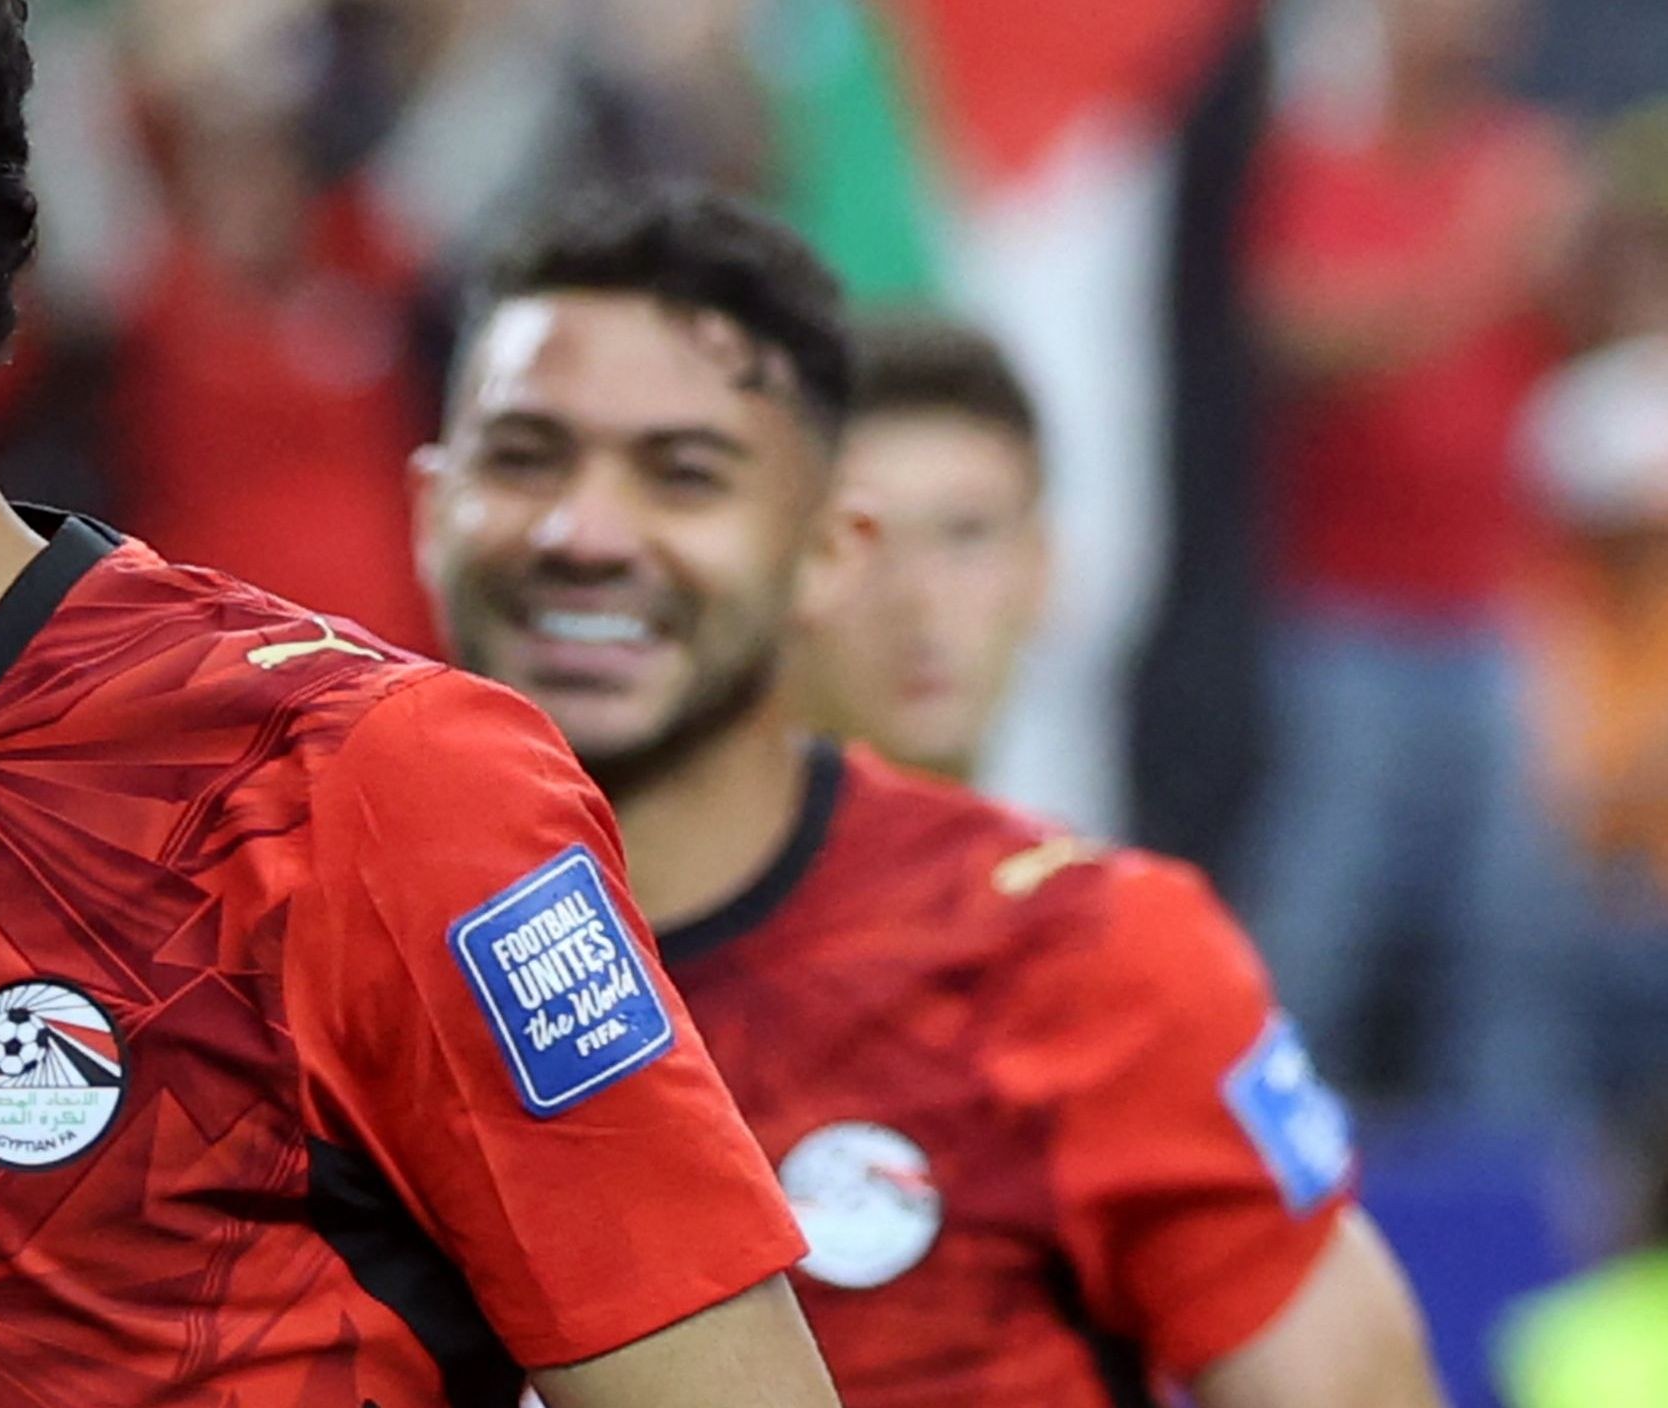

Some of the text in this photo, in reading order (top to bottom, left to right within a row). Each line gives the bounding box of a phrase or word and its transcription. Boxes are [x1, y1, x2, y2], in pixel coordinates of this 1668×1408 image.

[492, 890, 597, 971] FOOTBALL
[507, 920, 616, 1010] UNITES
[523, 957, 640, 1051] the World
[574, 1018, 628, 1057] FIFA
[58, 1129, 78, 1145] FA
